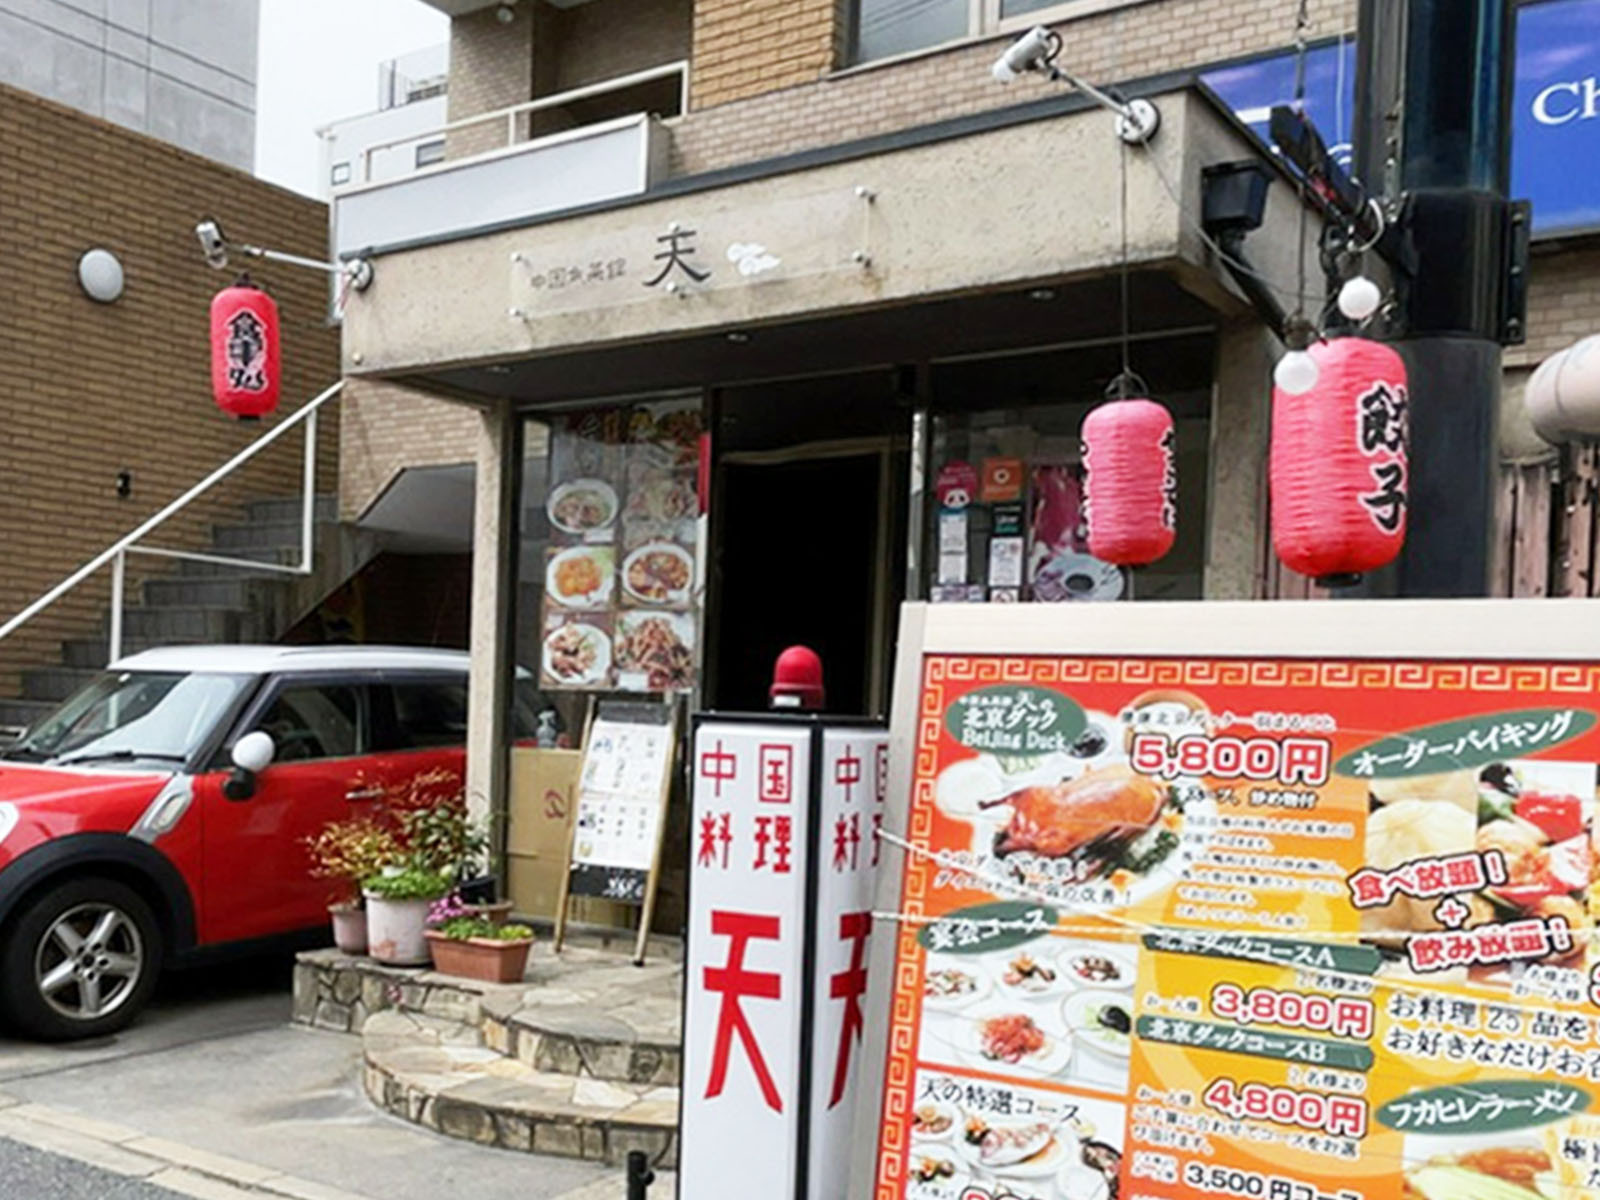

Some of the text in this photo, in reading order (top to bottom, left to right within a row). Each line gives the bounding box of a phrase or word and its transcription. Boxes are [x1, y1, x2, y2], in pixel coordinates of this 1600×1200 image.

[643, 229, 712, 287] 天
[961, 706, 1058, 731] 北京ダック
[1135, 738, 1326, 781] 5,800円
[1353, 711, 1574, 776] オーダーバイキング
[700, 739, 793, 804] 中国
[697, 811, 792, 873] 料理
[1351, 854, 1503, 903] 食べ放題!
[928, 909, 1051, 950] 宴会コース
[702, 909, 784, 1114] 天
[1214, 987, 1369, 1034] 3,800円
[1148, 1018, 1327, 1060] 北京ダックコースB
[919, 1077, 1081, 1125] 天の特選コース
[1208, 1083, 1364, 1133] 4,800円
[1387, 1088, 1579, 1128] フカヒレラーメン
